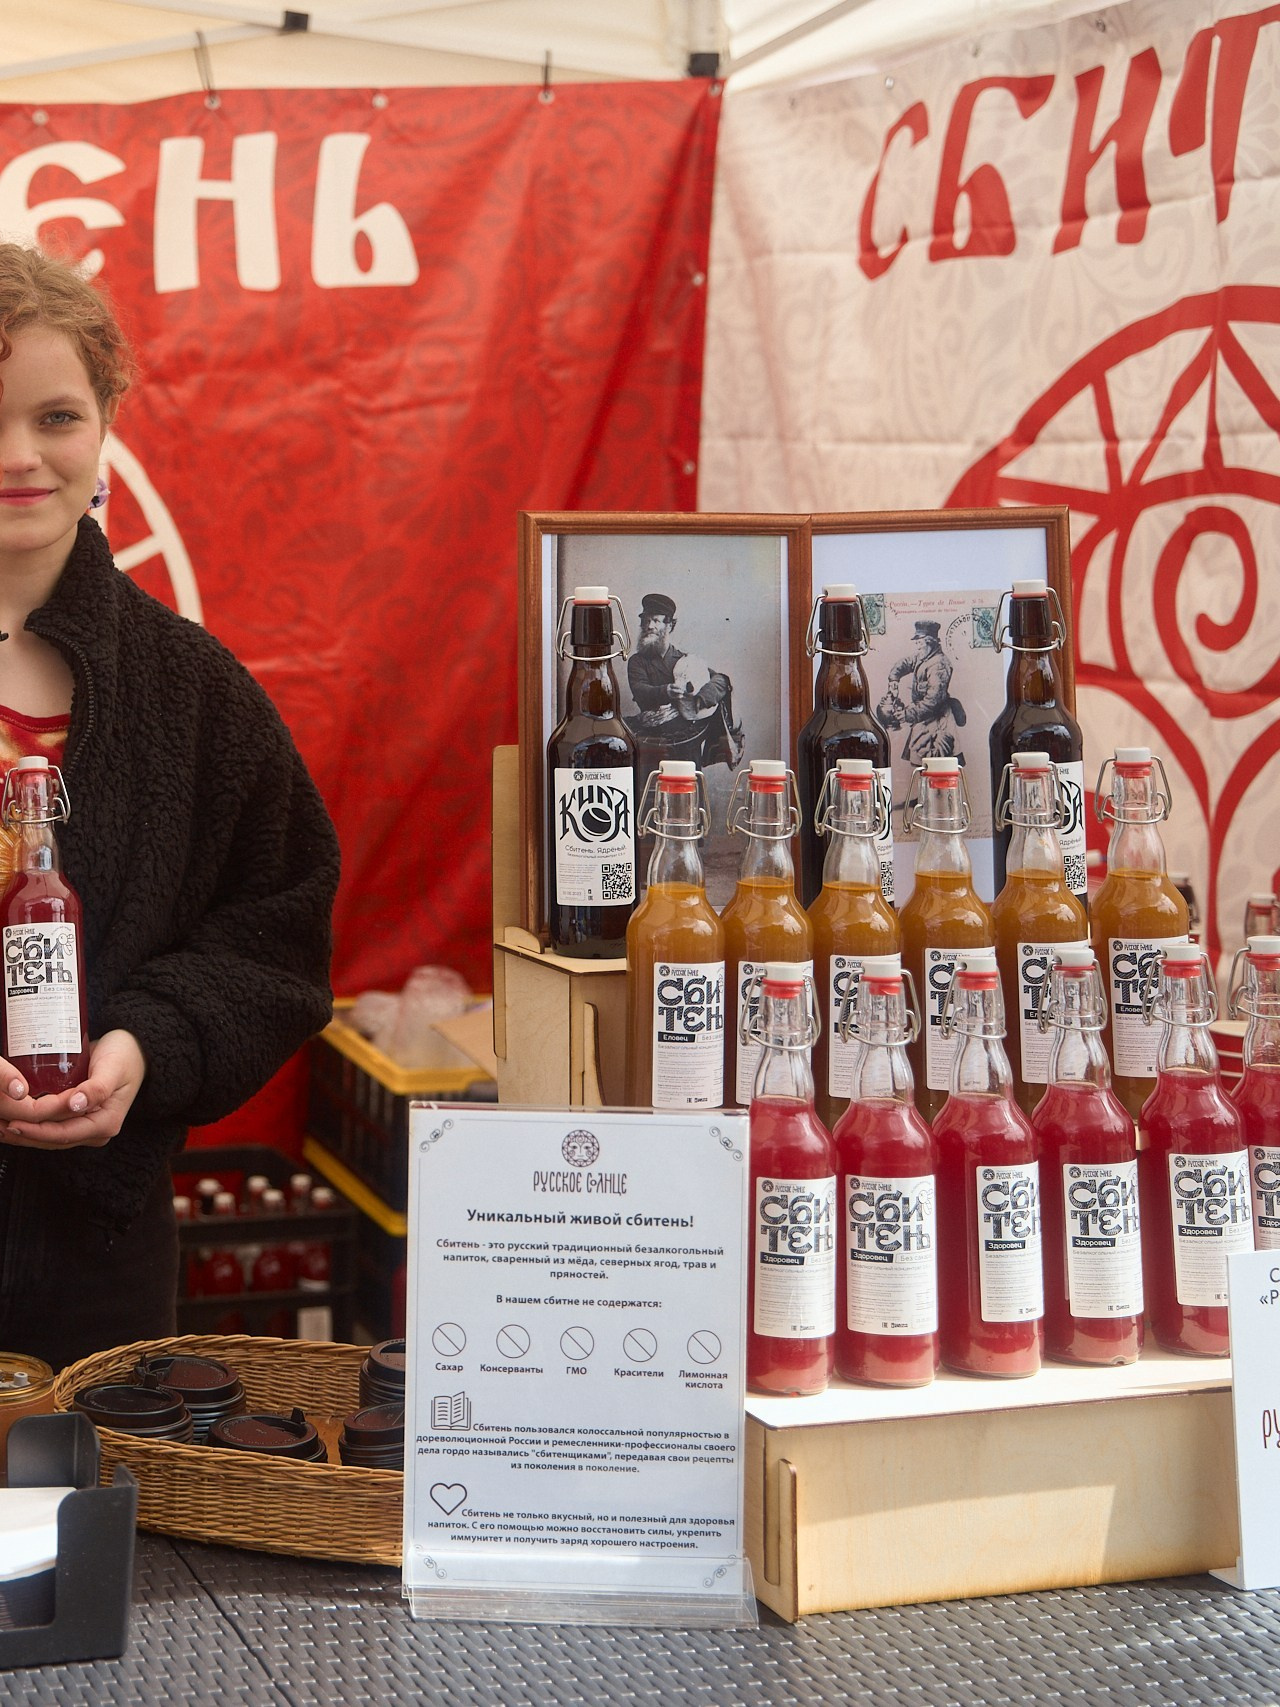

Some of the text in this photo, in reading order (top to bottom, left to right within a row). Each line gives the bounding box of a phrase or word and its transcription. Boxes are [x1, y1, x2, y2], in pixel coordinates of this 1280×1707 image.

[533, 1170, 582, 1193] РУССКОЕ
[466, 1208, 693, 1228] Уникальный живой сбитень!
[1182, 1227, 1218, 1235] Здоровец
[436, 1238, 480, 1248] Сбитень
[507, 1241, 549, 1251] русский
[551, 1243, 632, 1253] традиционный
[634, 1243, 723, 1256] безалкогольный
[1076, 1238, 1112, 1247] Здоровец
[443, 1254, 489, 1263] напиток,
[491, 1255, 550, 1265] сваренный
[567, 1256, 597, 1267] мёда,
[599, 1258, 651, 1268] северных
[653, 1260, 680, 1269] ягод,
[682, 1261, 707, 1270] трав
[764, 1254, 799, 1264] Здоровец
[853, 1251, 888, 1262] Здоровец
[549, 1270, 608, 1280] пряностей.
[505, 1296, 541, 1304] нашем
[543, 1295, 580, 1305] сбитне
[596, 1299, 662, 1309] содержатся:
[434, 1362, 463, 1373] Сахар
[479, 1363, 543, 1374] Консерванты
[565, 1366, 587, 1375] ГМО
[613, 1367, 664, 1378] Красители
[678, 1369, 727, 1379] Лимонная
[685, 1381, 723, 1389] кислота
[472, 1423, 512, 1432] Сбитень
[514, 1426, 575, 1434] пользовался
[577, 1428, 643, 1436] колоссальной
[646, 1430, 721, 1439] популярностью
[416, 1435, 506, 1444] дореволюционной
[508, 1436, 541, 1445] России
[551, 1439, 701, 1450] ремесленники-профессионалы
[417, 1447, 440, 1455] дела
[442, 1448, 470, 1456] гордо
[472, 1449, 529, 1457] назывались
[531, 1449, 612, 1460] "сбитенщиками",
[614, 1453, 665, 1462] передавая
[692, 1456, 733, 1464] рецепты
[585, 1465, 639, 1473] поколение.
[461, 1508, 500, 1517] Сбитень
[551, 1512, 594, 1522] вкусный,
[619, 1514, 667, 1523] полезный
[668, 1517, 686, 1525] для
[689, 1517, 734, 1526] здоровья
[497, 1523, 544, 1532] помощью
[580, 1526, 645, 1534] восстановить
[647, 1528, 674, 1536] силы,
[676, 1529, 721, 1538] укрепить
[450, 1534, 503, 1543] иммунитет
[513, 1536, 558, 1545] получить
[560, 1537, 588, 1546] заряд
[590, 1539, 637, 1547] хорошего
[639, 1540, 698, 1549] настроения.
